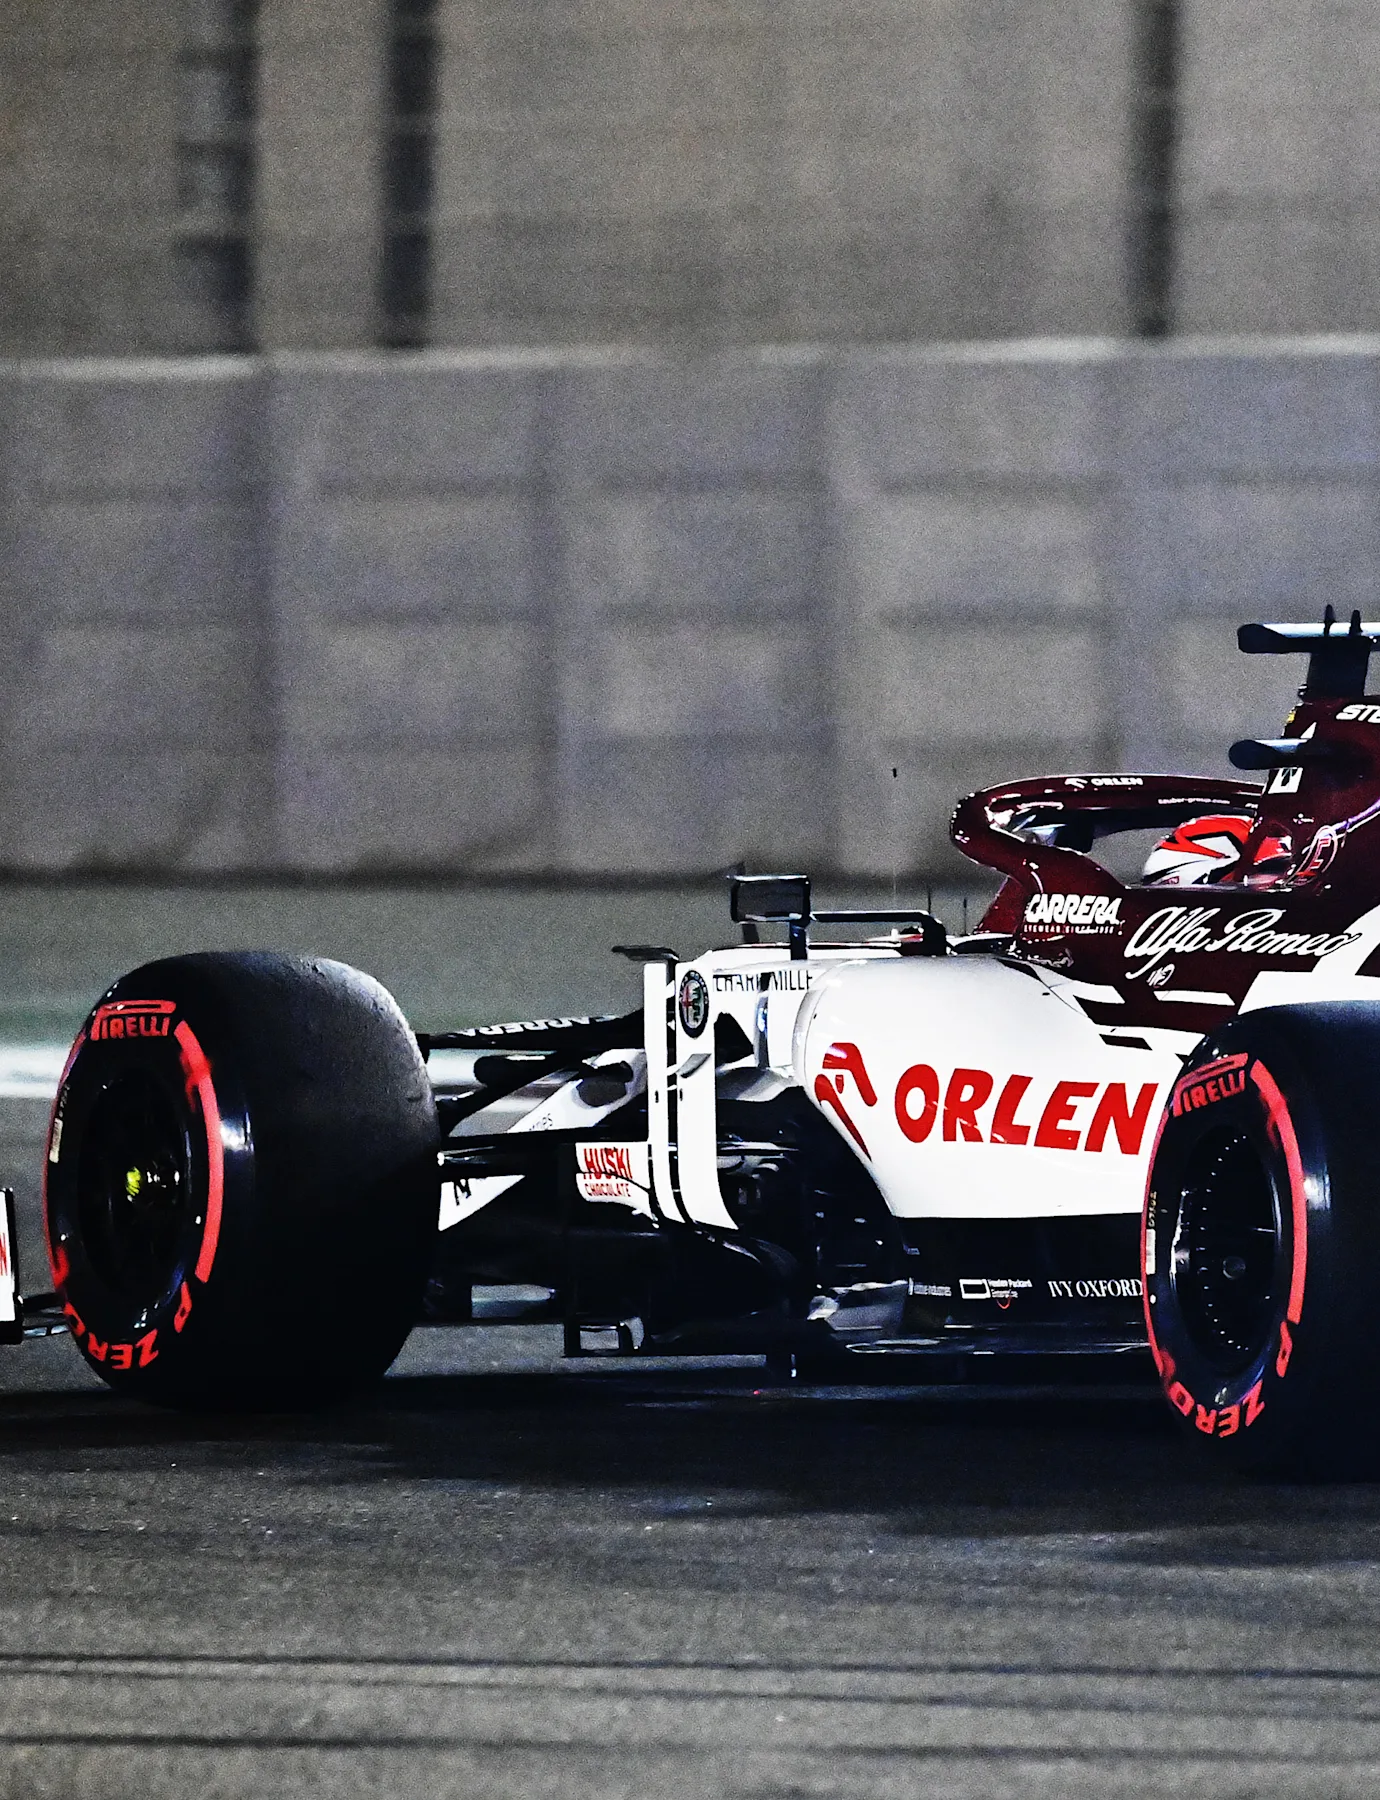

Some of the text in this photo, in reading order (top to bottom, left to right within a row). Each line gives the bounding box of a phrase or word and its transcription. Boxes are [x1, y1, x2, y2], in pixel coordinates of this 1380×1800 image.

[1091, 777, 1143, 786] ORLEN
[1024, 894, 1123, 924] CARRERA
[1124, 906, 1221, 979] Alfa
[1206, 908, 1363, 956] Romeo
[91, 1000, 176, 1040] PIRELLI
[1173, 1052, 1248, 1117] PIRELLI
[894, 1063, 1159, 1155] ORLEN
[583, 1147, 633, 1179] HUSKI
[584, 1183, 631, 1197] CHOCOLATE
[1048, 1279, 1143, 1297] IVY OXFORD
[64, 1302, 158, 1369] ZERO
[1169, 1380, 1266, 1438] ZERO
